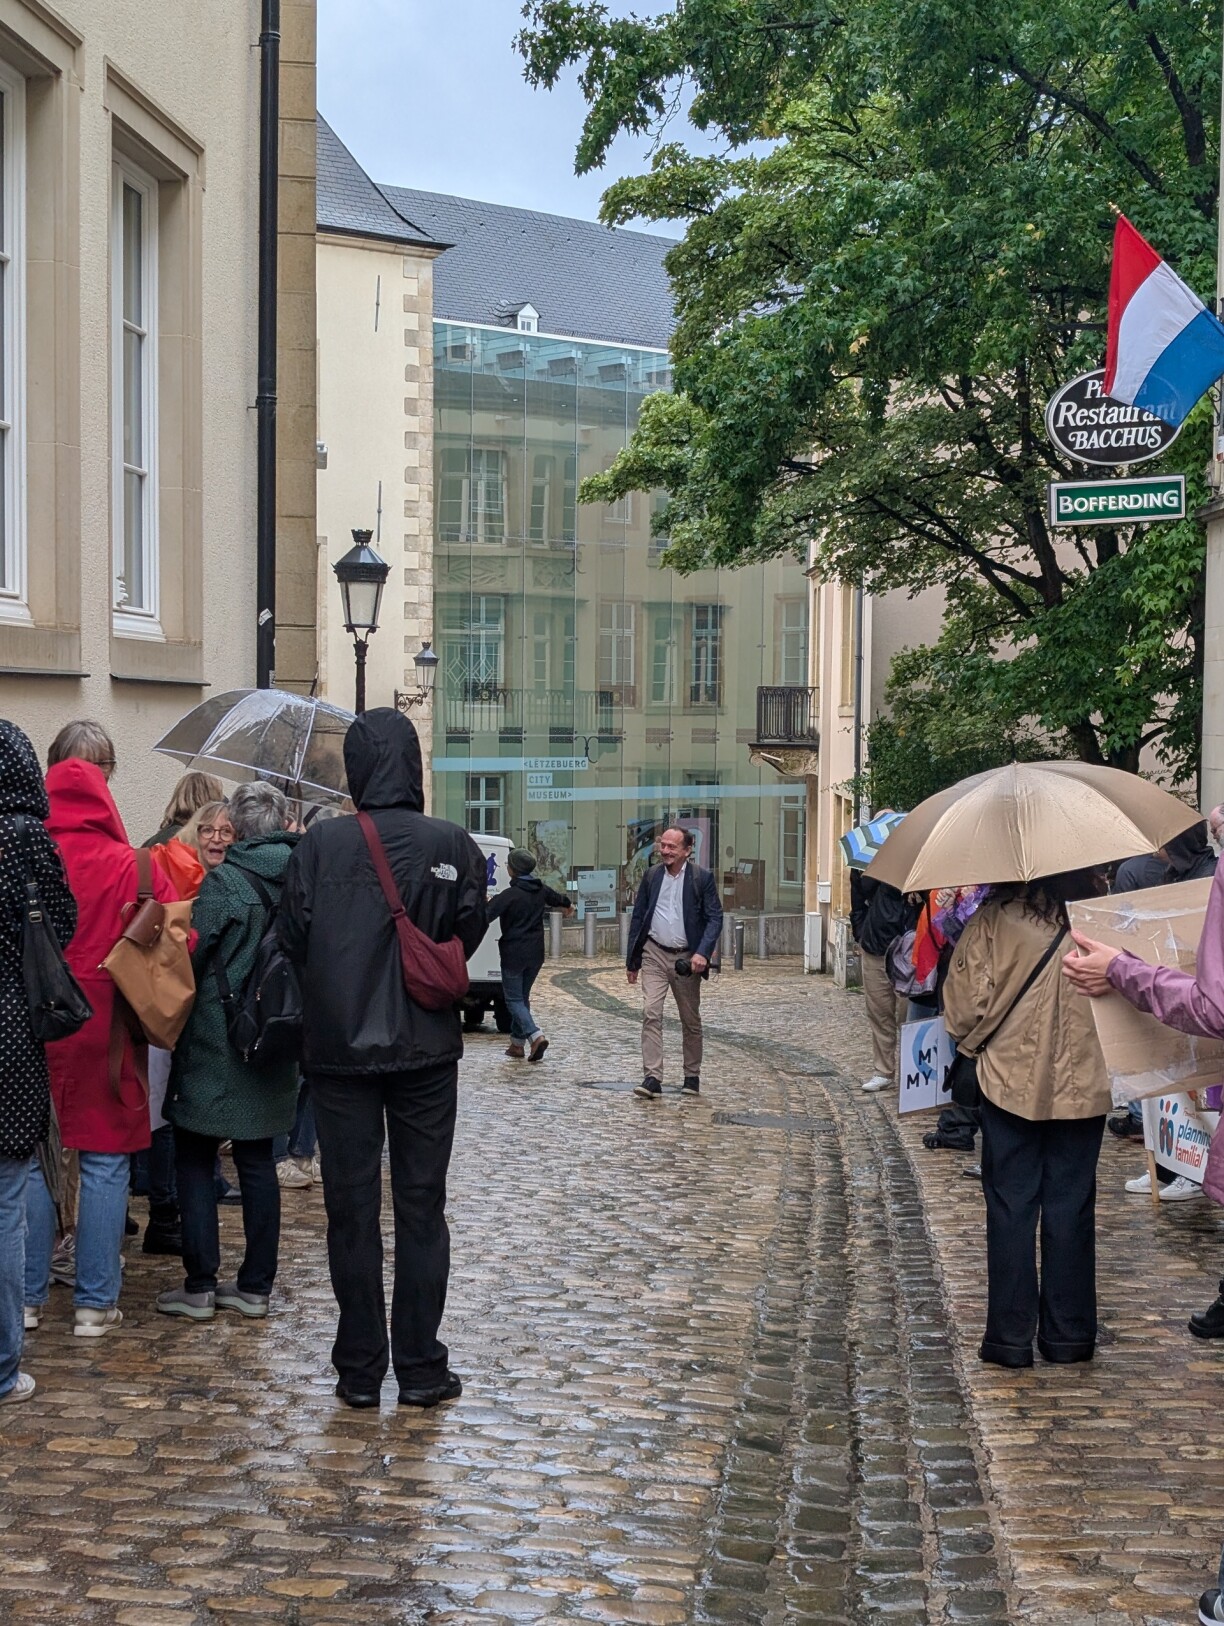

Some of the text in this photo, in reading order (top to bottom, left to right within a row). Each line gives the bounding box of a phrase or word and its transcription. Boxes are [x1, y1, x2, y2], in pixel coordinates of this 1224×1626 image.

[1068, 425, 1163, 450] BACCHUS
[1058, 489, 1180, 514] BOFFERDING
[528, 775, 551, 784] CITY
[906, 1068, 933, 1090] MY
[1175, 1137, 1206, 1169] familial
